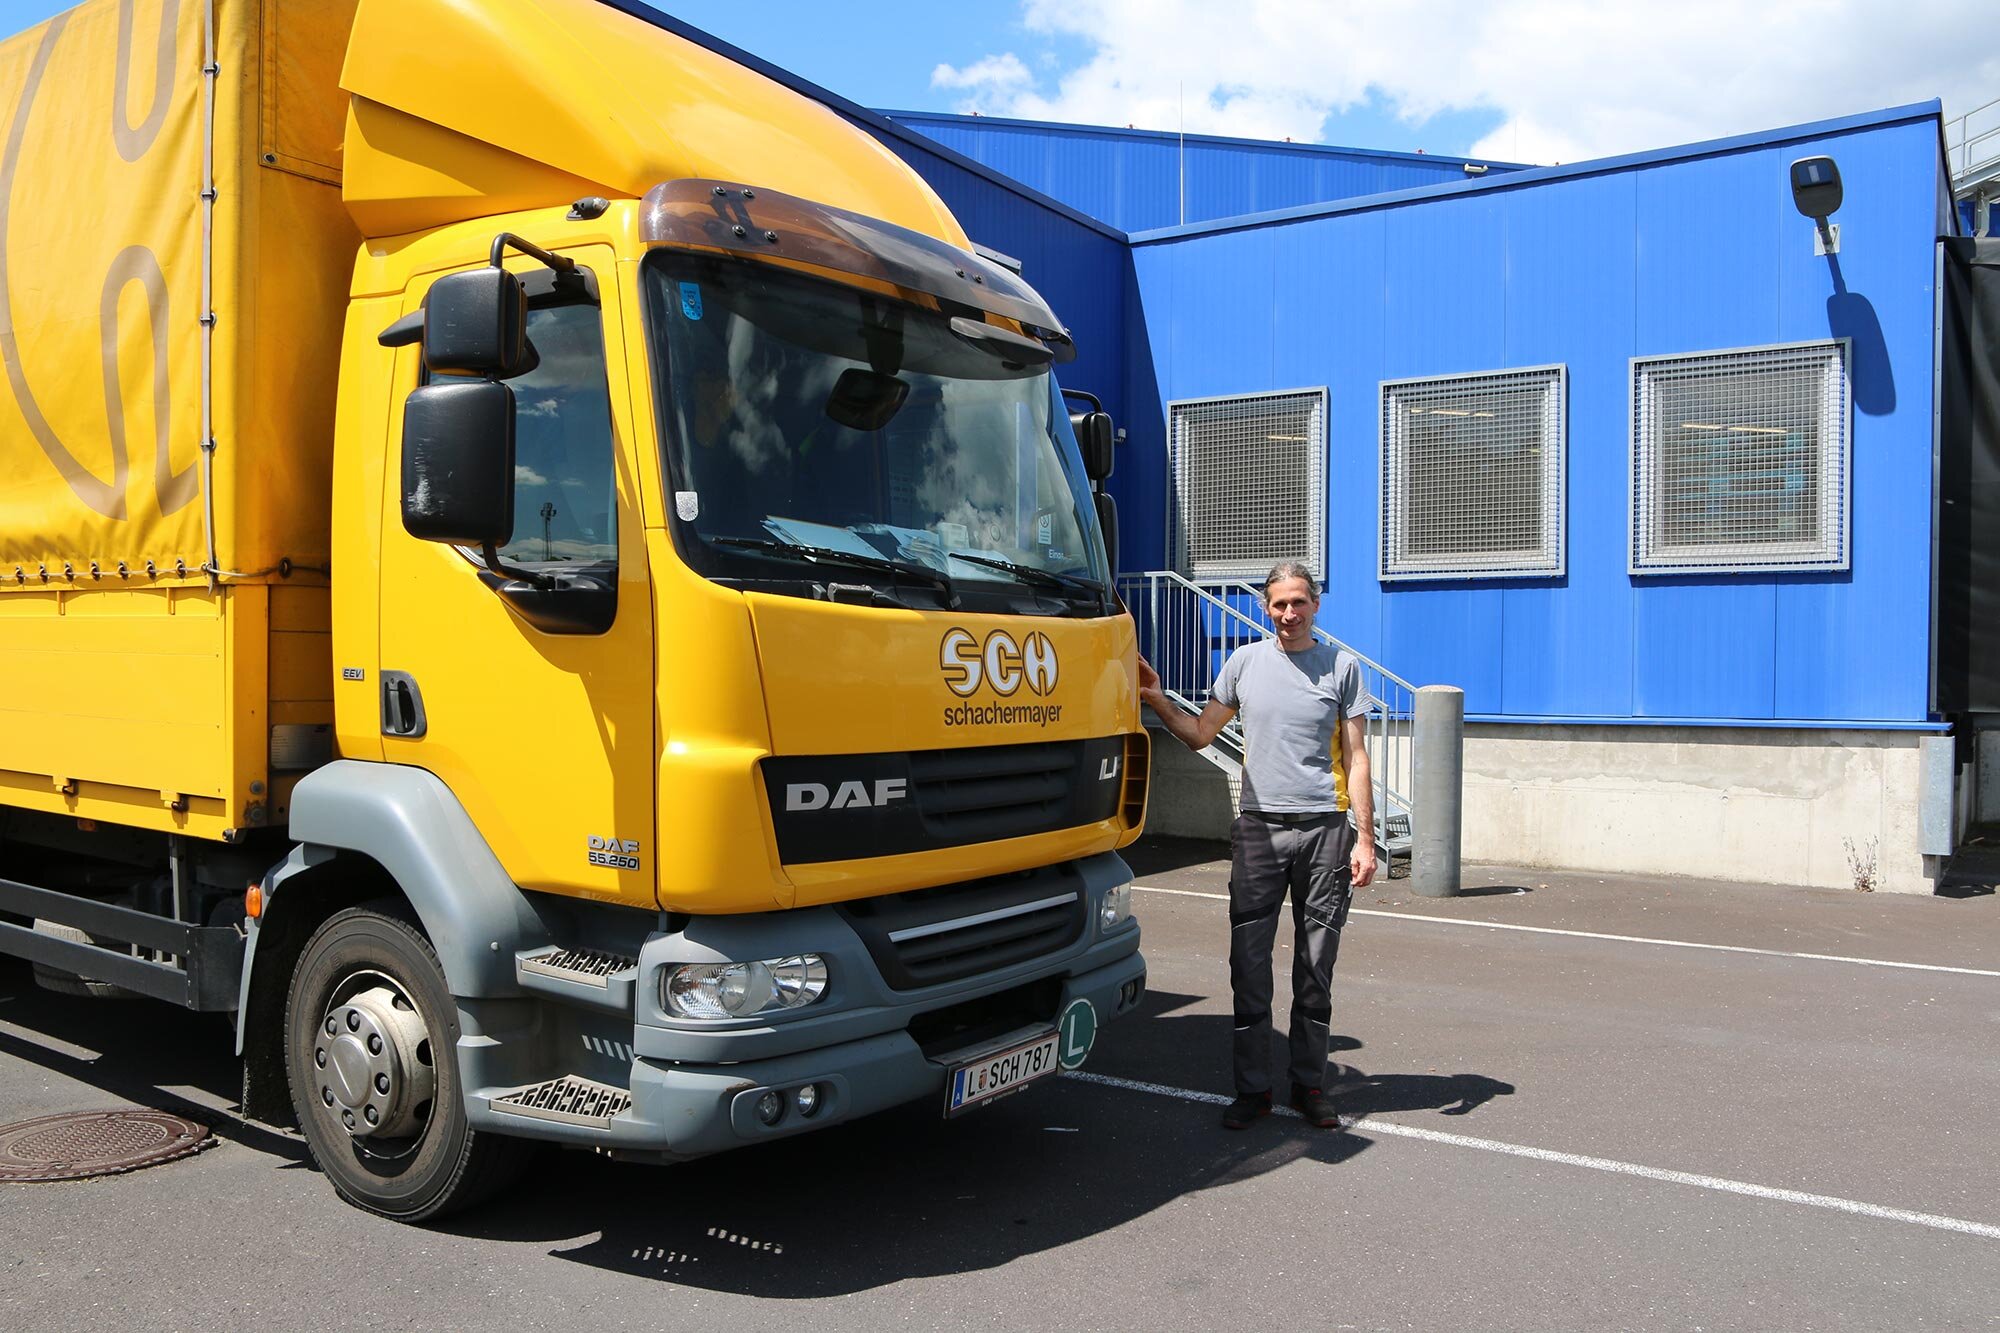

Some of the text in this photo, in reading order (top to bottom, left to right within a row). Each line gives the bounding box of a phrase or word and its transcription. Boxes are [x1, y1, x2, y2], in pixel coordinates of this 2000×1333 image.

[343, 668, 362, 678] EEV
[939, 626, 1059, 698] SCH
[944, 700, 1062, 728] schachermayer
[786, 778, 907, 811] DAF
[588, 834, 639, 854] DAF
[588, 851, 637, 869] 55.250
[1067, 1014, 1084, 1058] L
